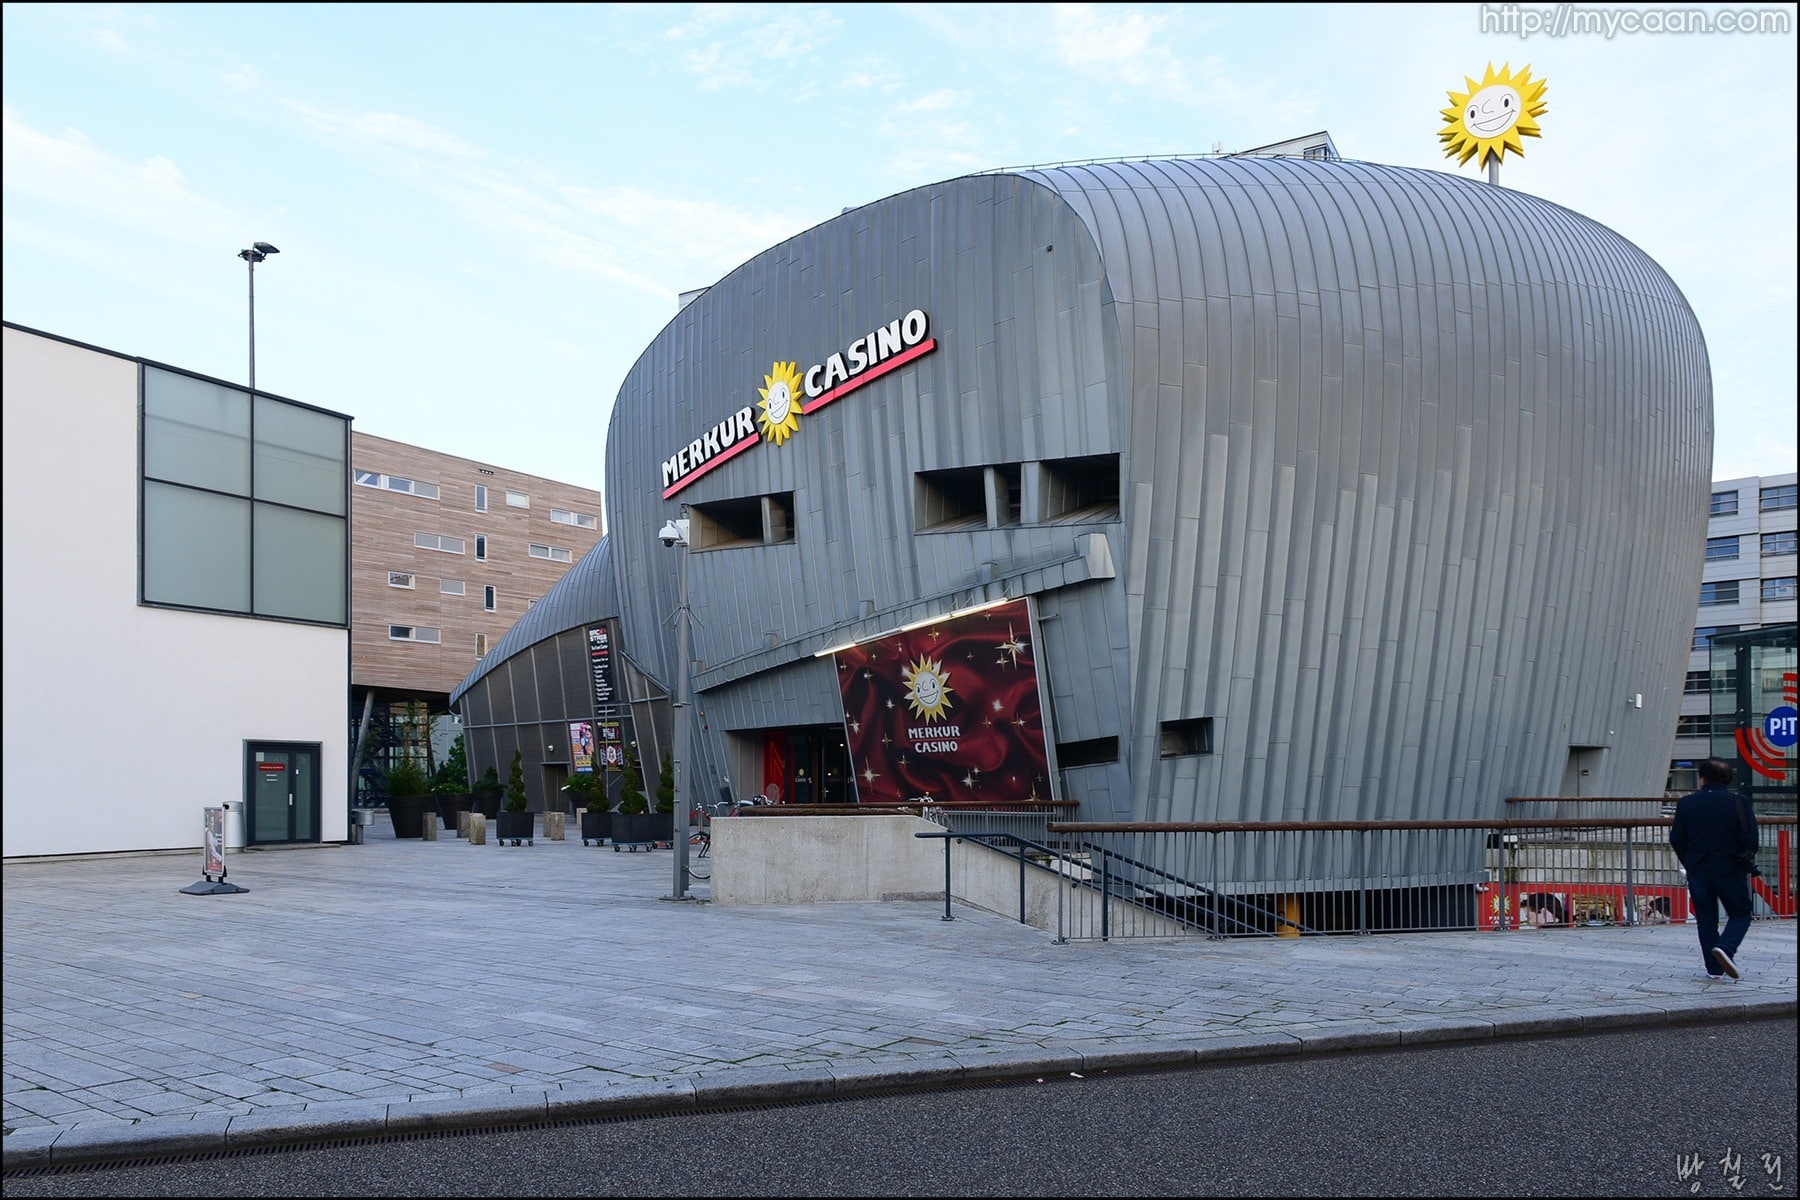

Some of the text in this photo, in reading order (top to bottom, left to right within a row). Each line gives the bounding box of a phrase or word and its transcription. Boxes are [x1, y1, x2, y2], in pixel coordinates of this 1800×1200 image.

[661, 308, 928, 488] MERKUR CASINO
[908, 724, 961, 739] MERKUR
[914, 739, 959, 754] CASINO
